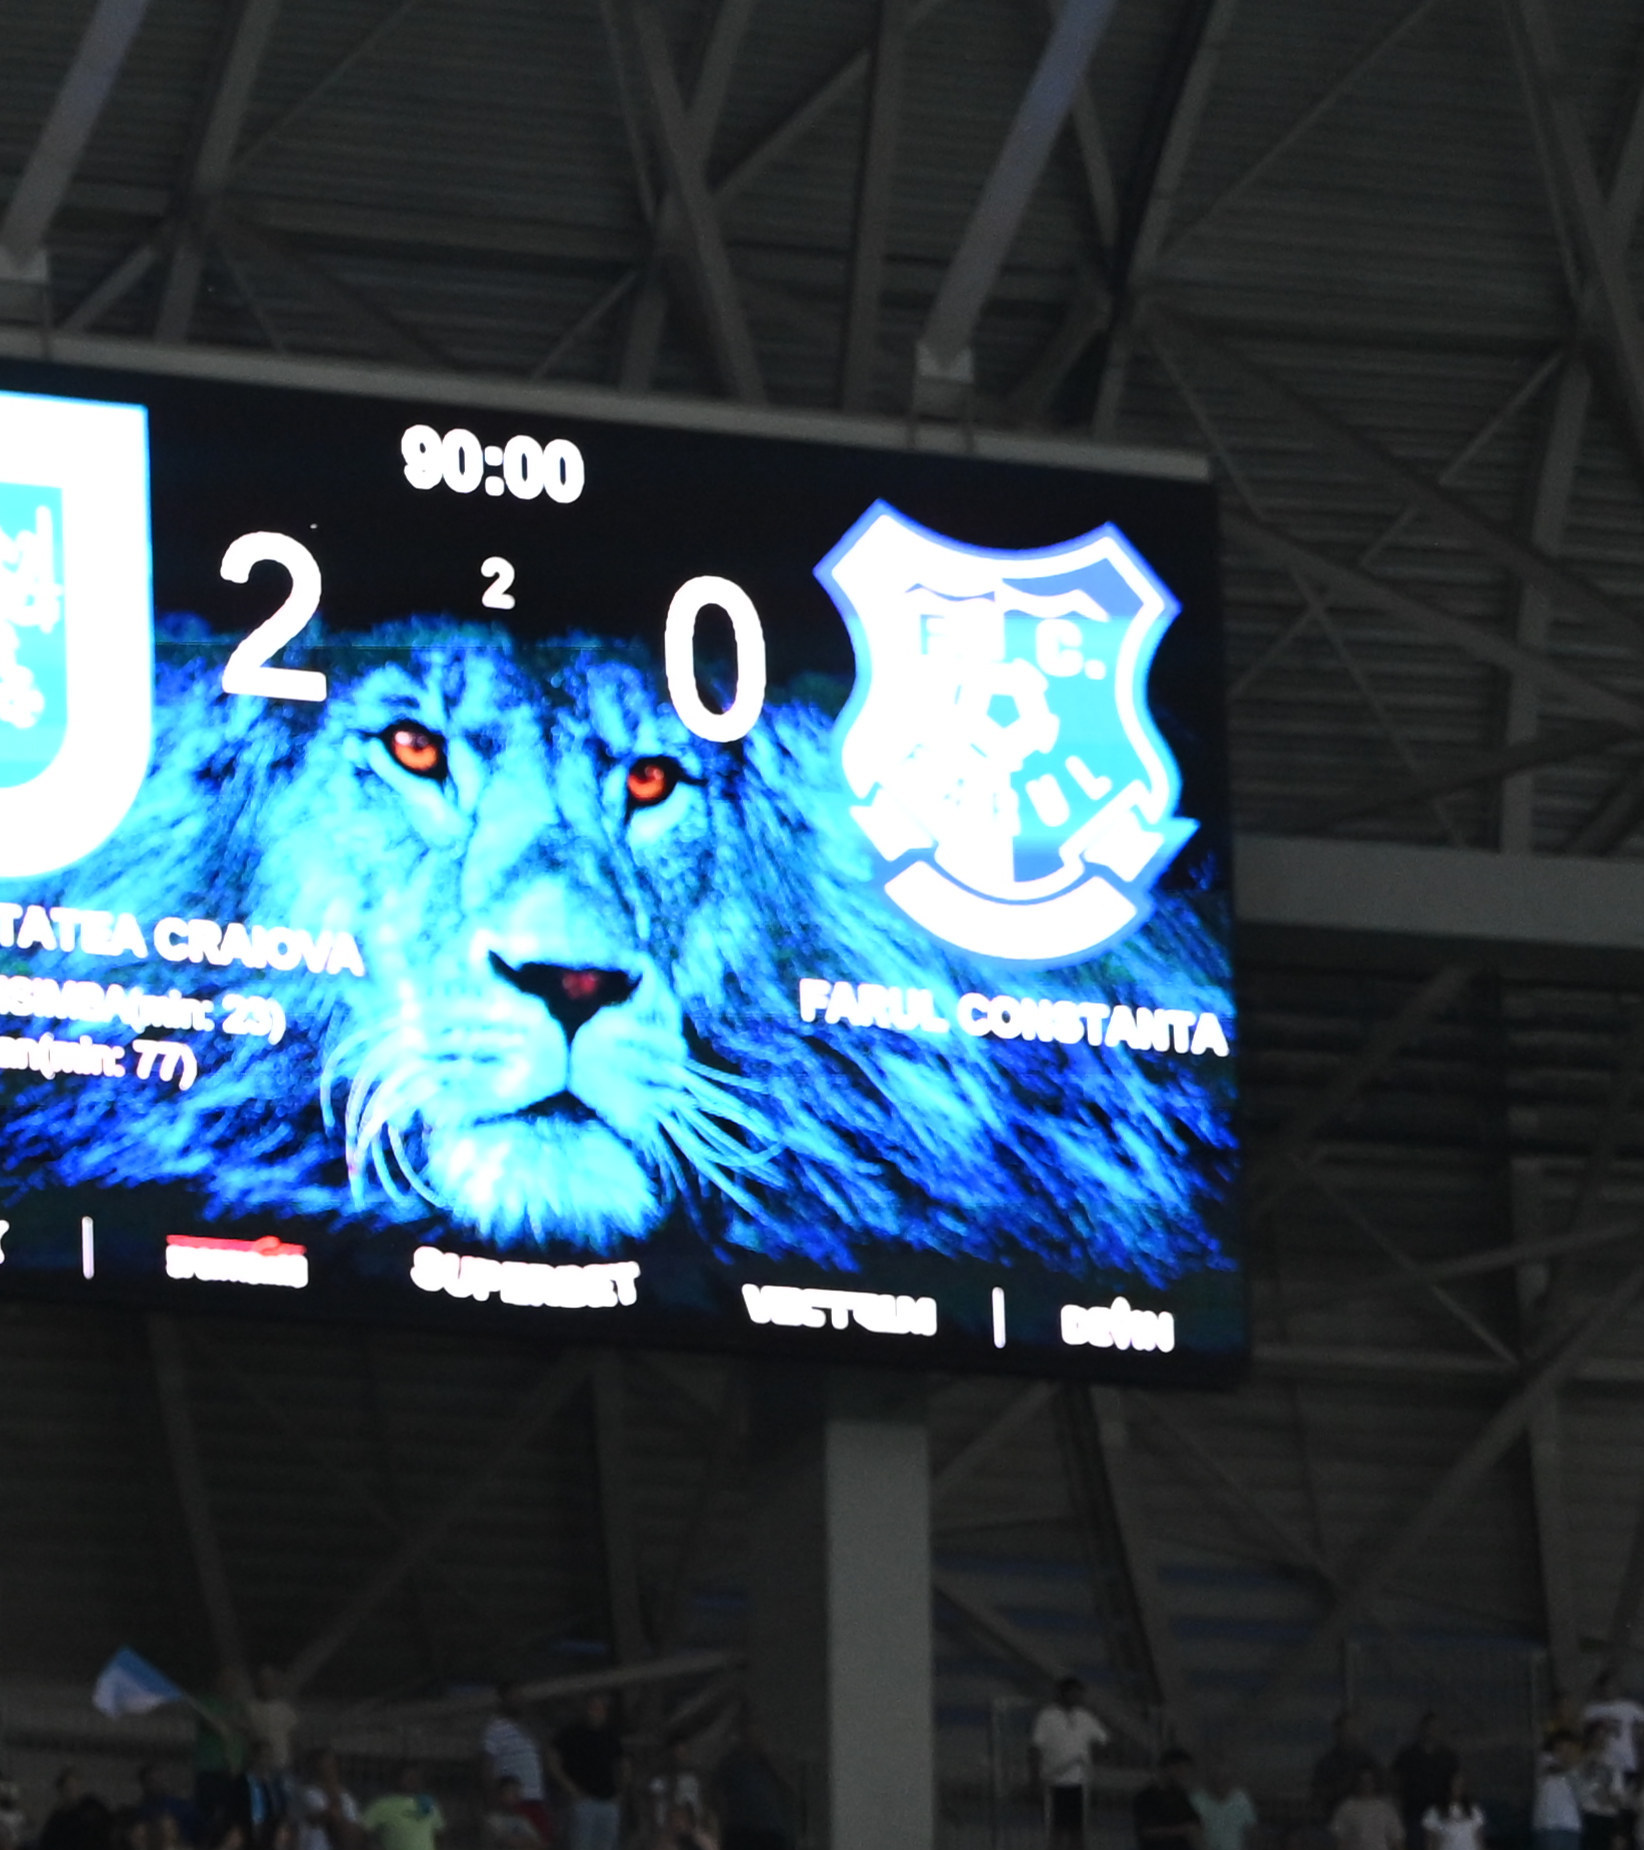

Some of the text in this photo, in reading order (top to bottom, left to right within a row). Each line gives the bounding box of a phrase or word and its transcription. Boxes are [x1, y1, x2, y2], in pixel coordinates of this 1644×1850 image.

[401, 424, 585, 504] 90:00
[218, 530, 328, 703] 2
[480, 556, 515, 610] 2
[663, 575, 767, 743] 0
[153, 915, 366, 977] CRAIOVA
[799, 977, 1230, 1057] FARUL CONSTANTA
